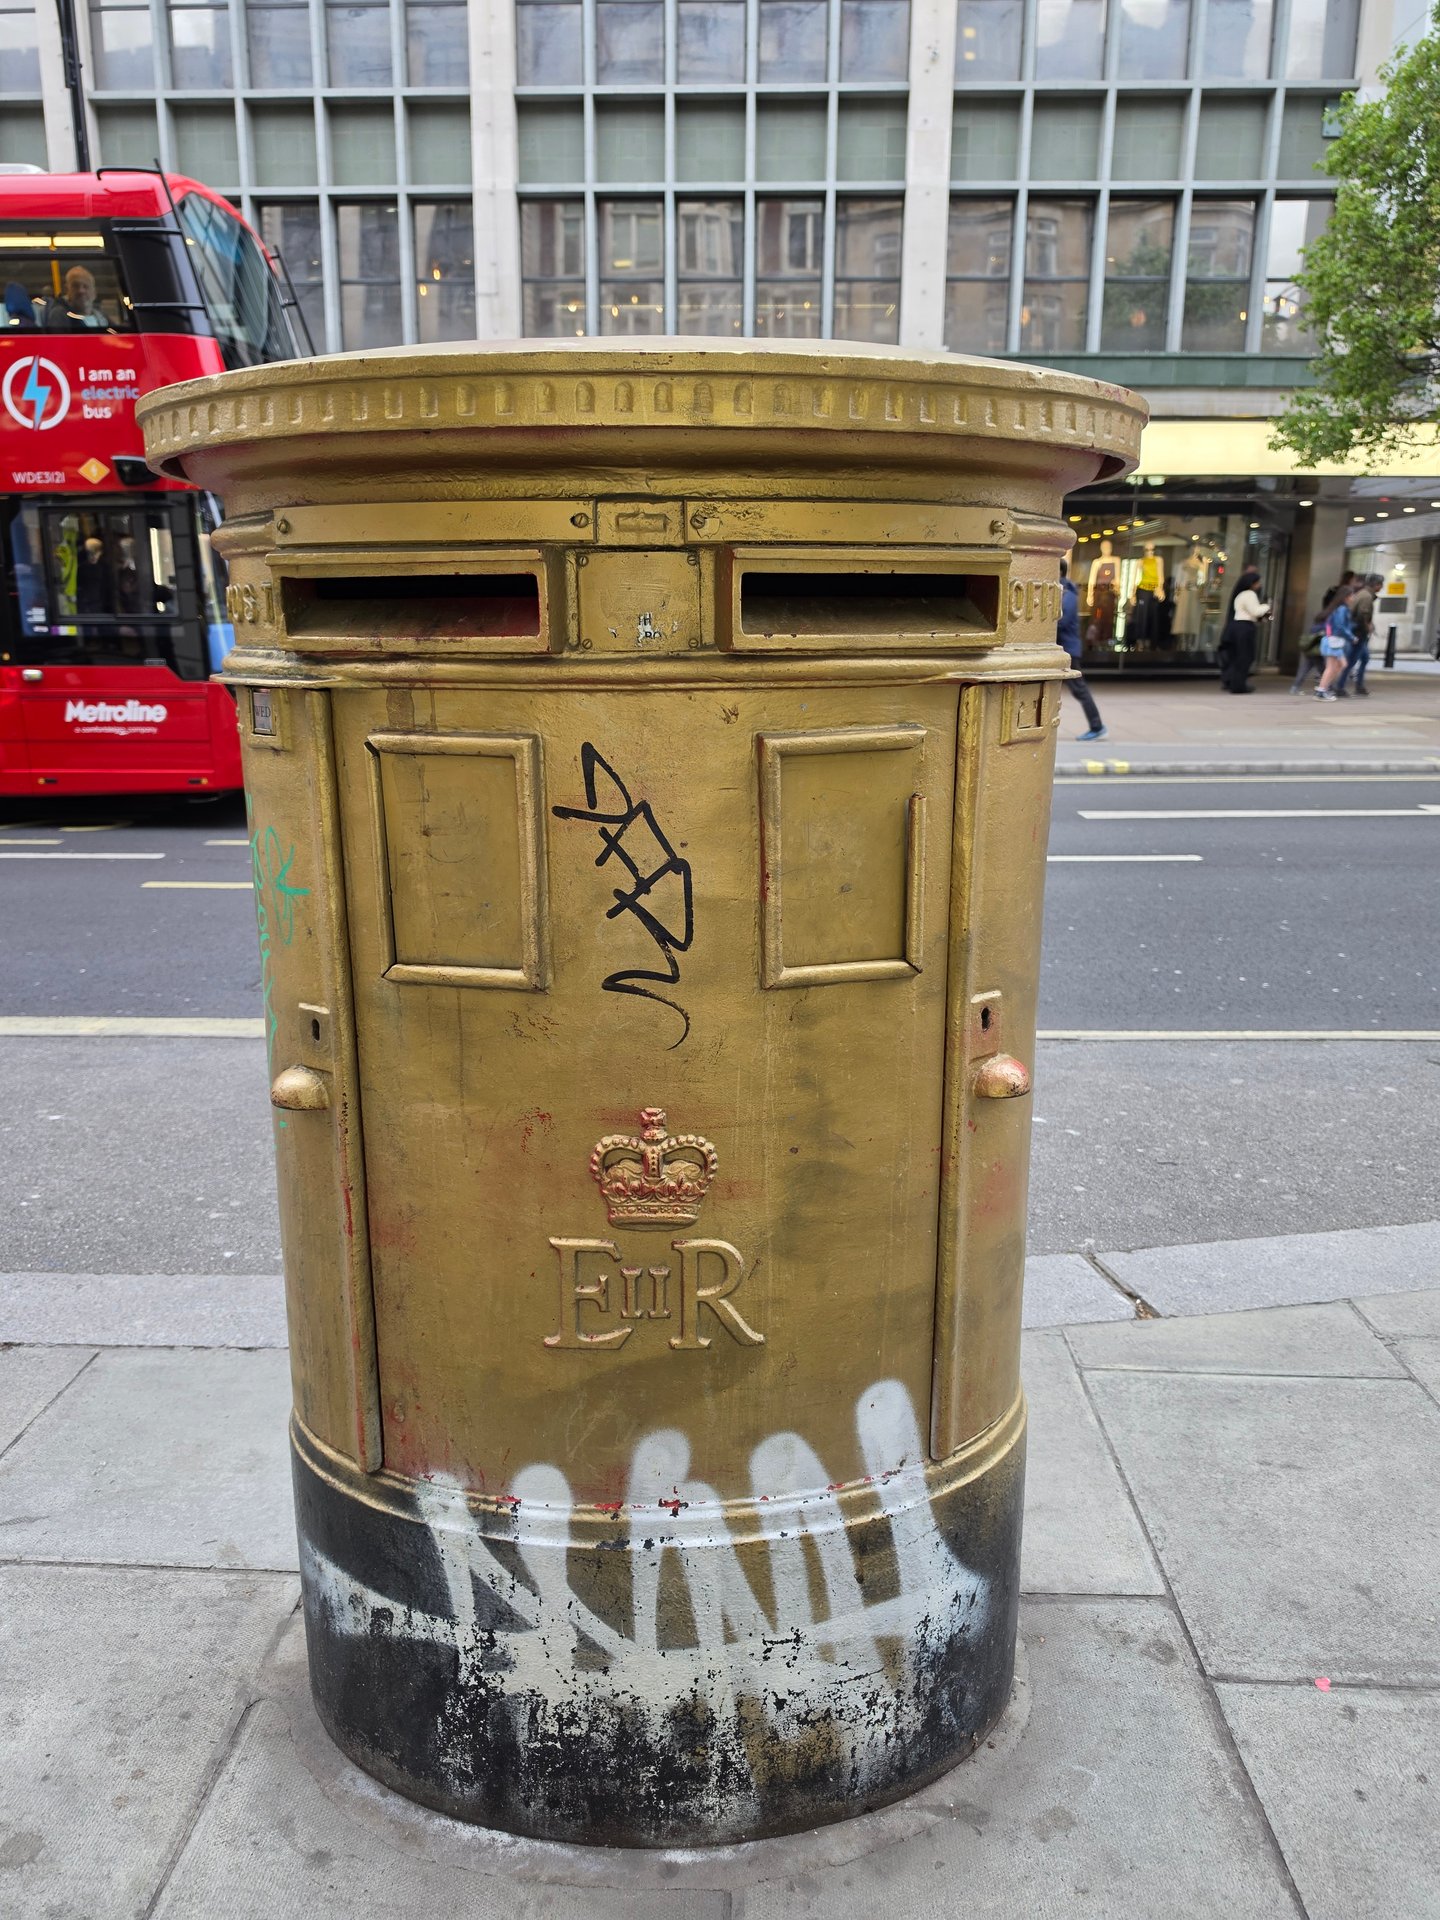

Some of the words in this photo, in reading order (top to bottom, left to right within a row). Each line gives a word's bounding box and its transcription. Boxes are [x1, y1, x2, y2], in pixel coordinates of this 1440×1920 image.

[79, 366, 86, 382] I
[88, 369, 113, 382] am
[115, 368, 136, 381] an
[81, 385, 140, 400] electric
[83, 404, 112, 419] bus
[64, 699, 168, 723] Metroline
[254, 705, 271, 717] WED
